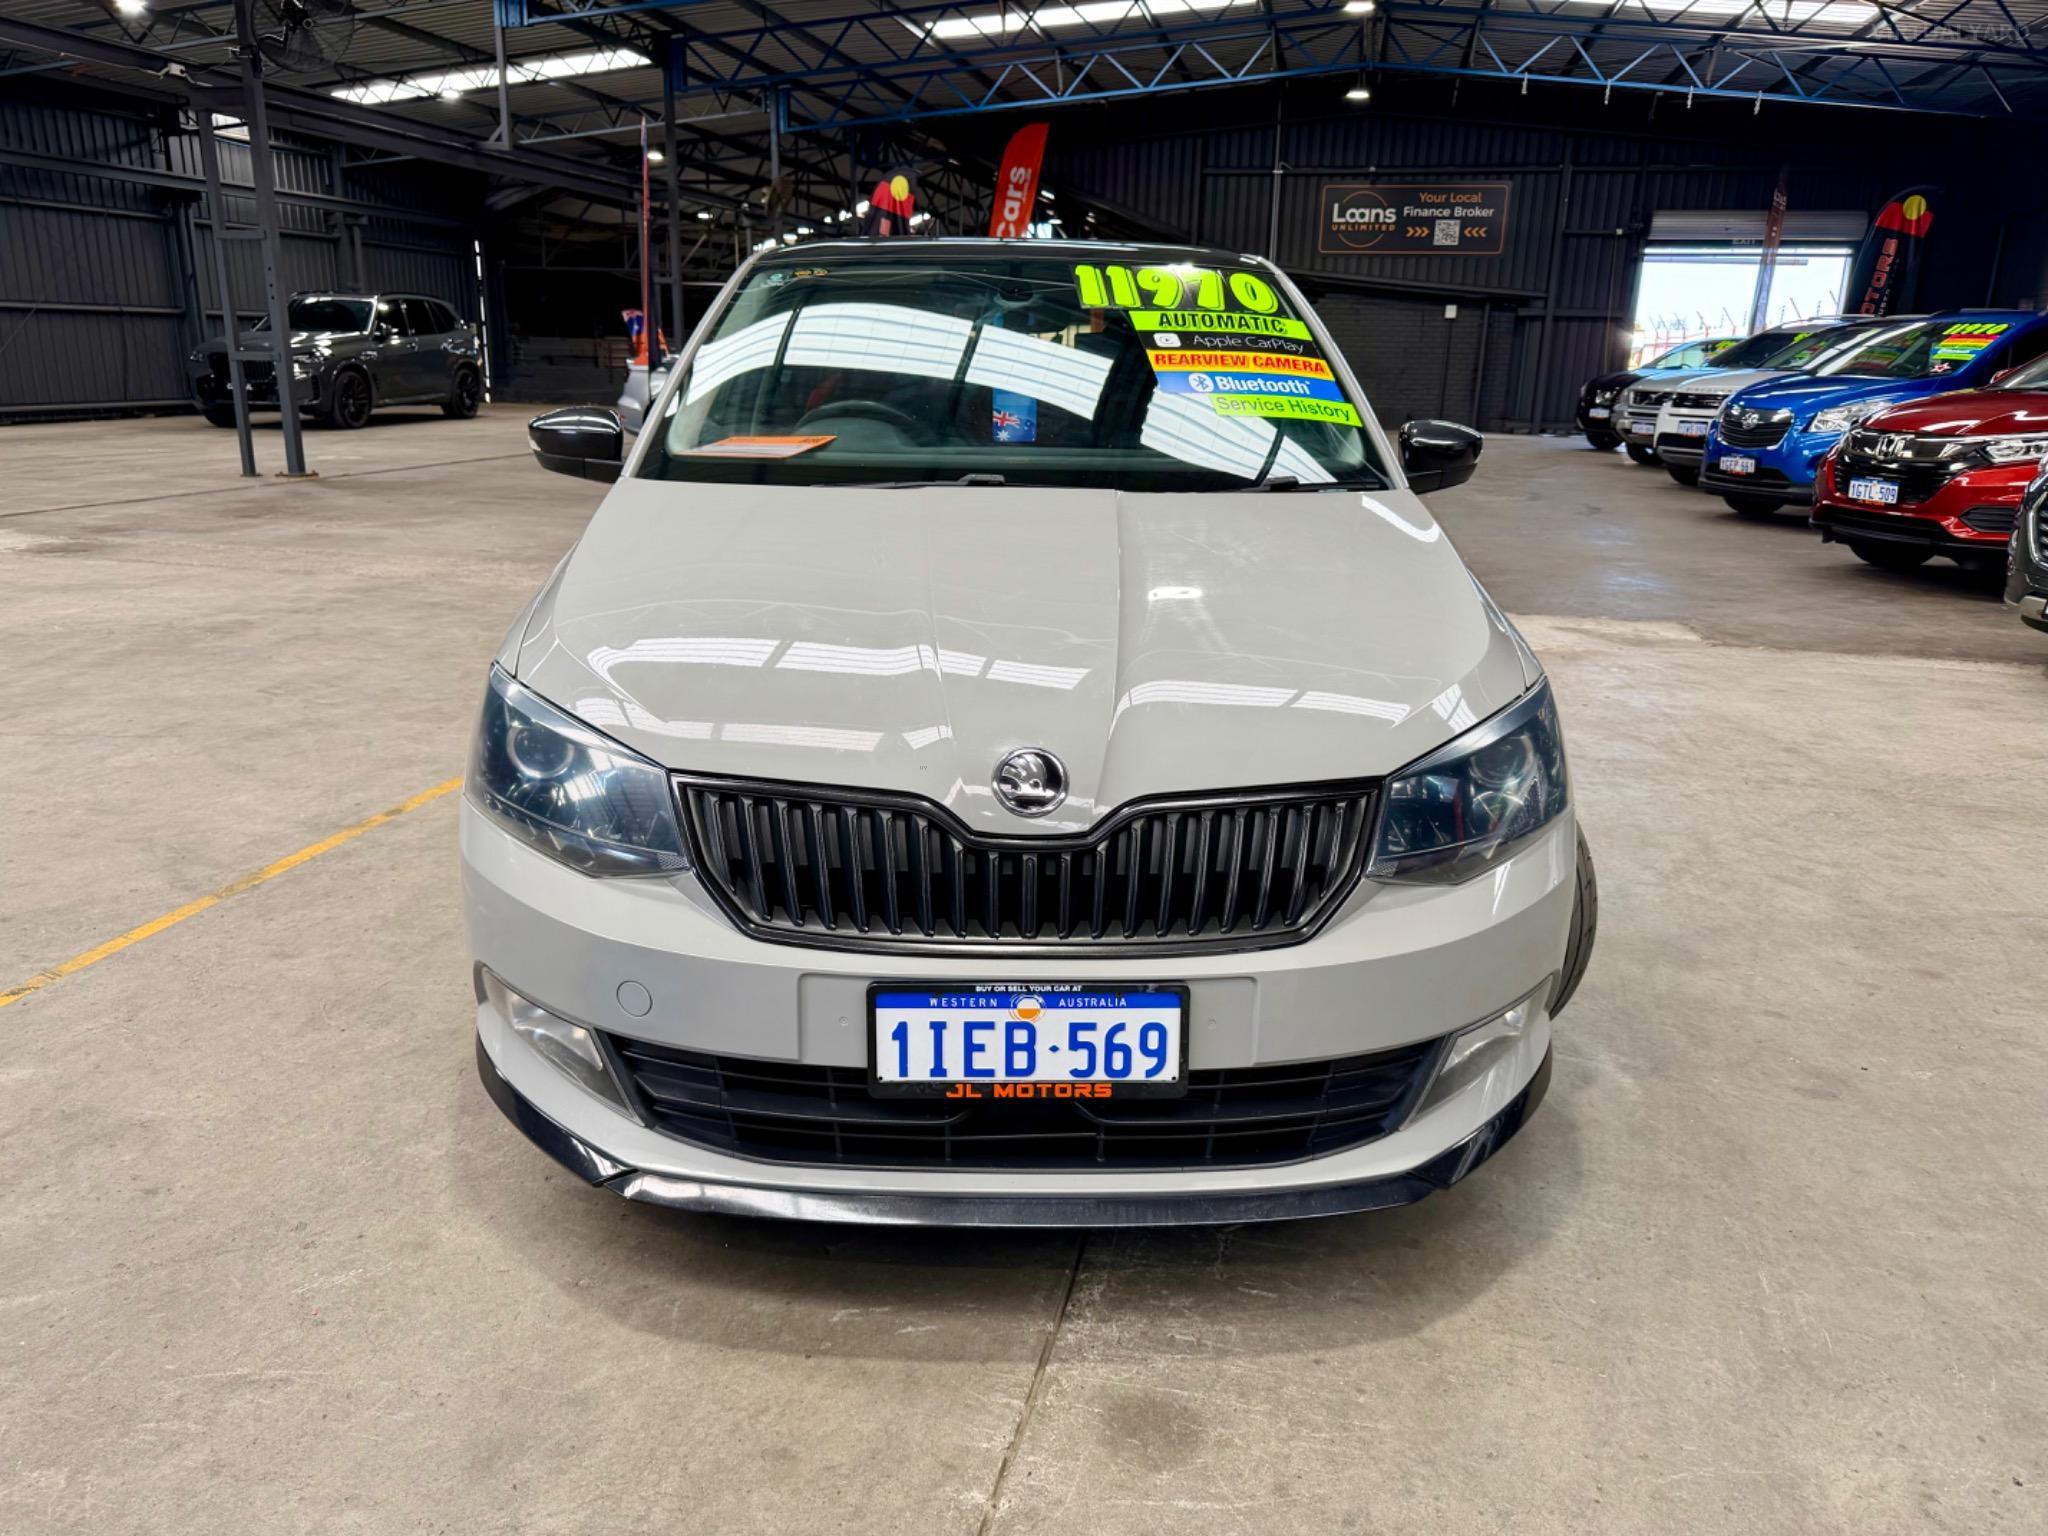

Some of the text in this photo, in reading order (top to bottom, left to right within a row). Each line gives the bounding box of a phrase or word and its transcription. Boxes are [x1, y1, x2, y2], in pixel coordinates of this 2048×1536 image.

[996, 166, 1025, 238] Cars
[1419, 192, 1482, 203] Your Local
[1332, 203, 1397, 223] Loans
[1403, 206, 1495, 217] Finance Broker
[1859, 238, 1898, 315] OTORS
[1075, 265, 1279, 313] 11970
[1158, 312, 1288, 335] AUTOMATIC
[1193, 335, 1304, 354] Apple CarPlay
[1155, 353, 1326, 373] REARVIEW CAMERA
[1215, 375, 1310, 395] Bluetooth
[1216, 397, 1350, 421] Service History
[929, 998, 1127, 1008] WESTERN AUSTRALIA
[946, 1083, 1113, 1098] JL MOTORS
